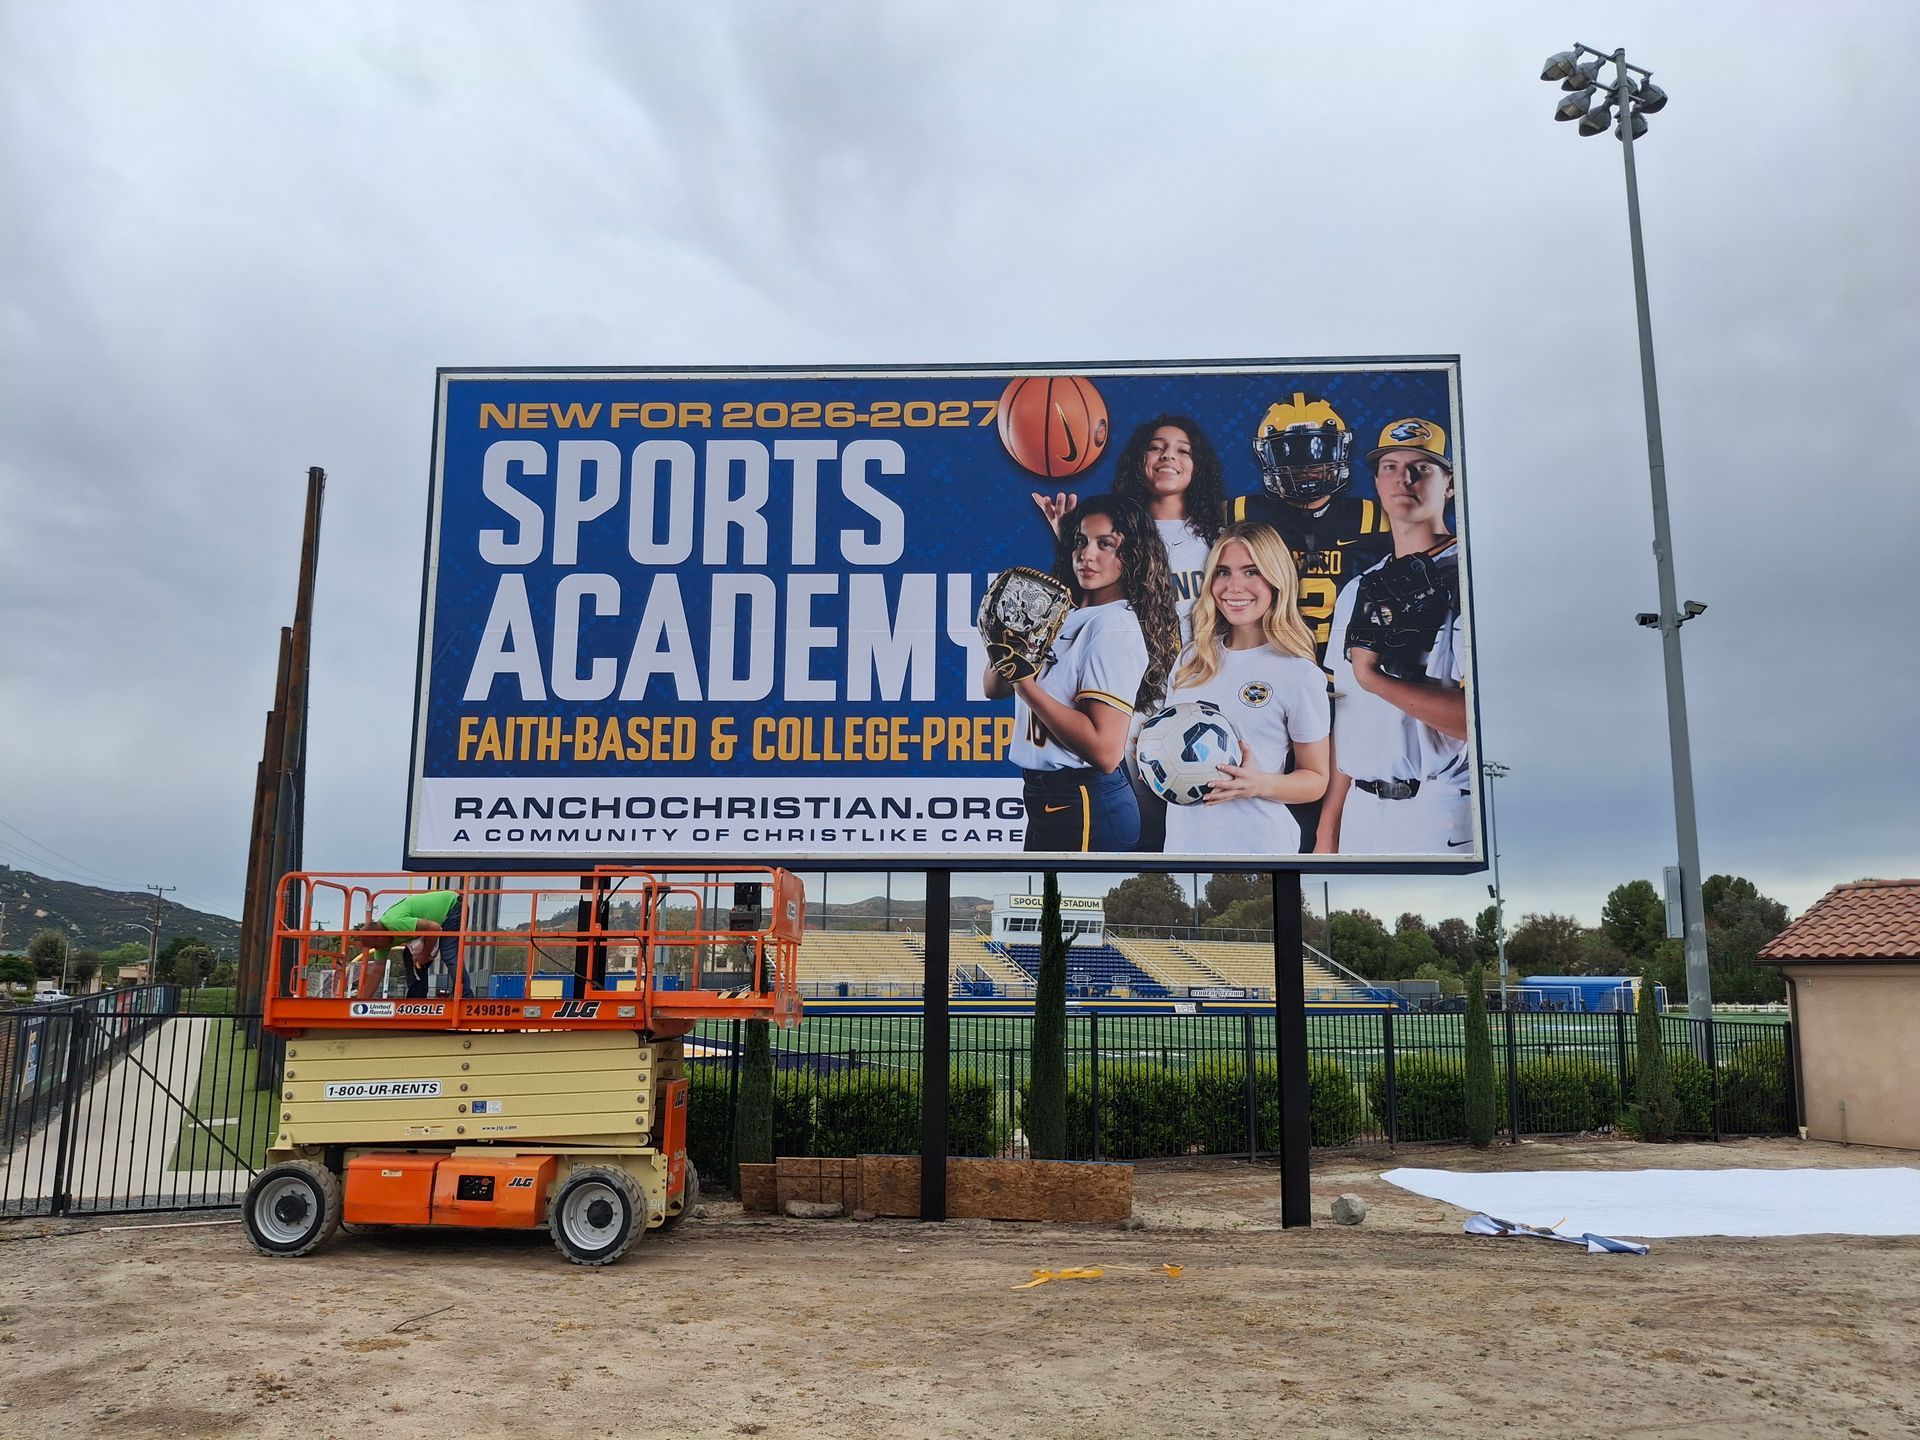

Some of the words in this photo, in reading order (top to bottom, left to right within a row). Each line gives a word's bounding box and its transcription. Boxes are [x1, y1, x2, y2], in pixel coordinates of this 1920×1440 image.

[479, 402, 602, 429] NEW
[610, 402, 712, 428] FOR
[722, 401, 998, 428] 2026-2027
[478, 439, 906, 566] SPORTS
[462, 573, 999, 702] ACADEMY
[458, 716, 697, 761] FAITH-BASED
[710, 716, 738, 761] &
[752, 716, 1015, 761] COLLEGE-PREP
[454, 796, 1024, 819] RANCHOCHRISTIAN.ORG
[453, 829, 471, 842] A
[485, 828, 678, 842] COMMUNITY
[692, 828, 730, 842] OF
[743, 828, 928, 842] CHRISTLIKE
[941, 828, 1024, 842] CARE
[1063, 900, 1100, 908] STADIUM
[397, 1004, 444, 1015] 4069LE
[466, 1005, 511, 1017] 249838
[553, 1001, 601, 1019] JLG
[328, 1083, 438, 1096] 1-800-UR-RENTS
[508, 1177, 534, 1188] JLG
